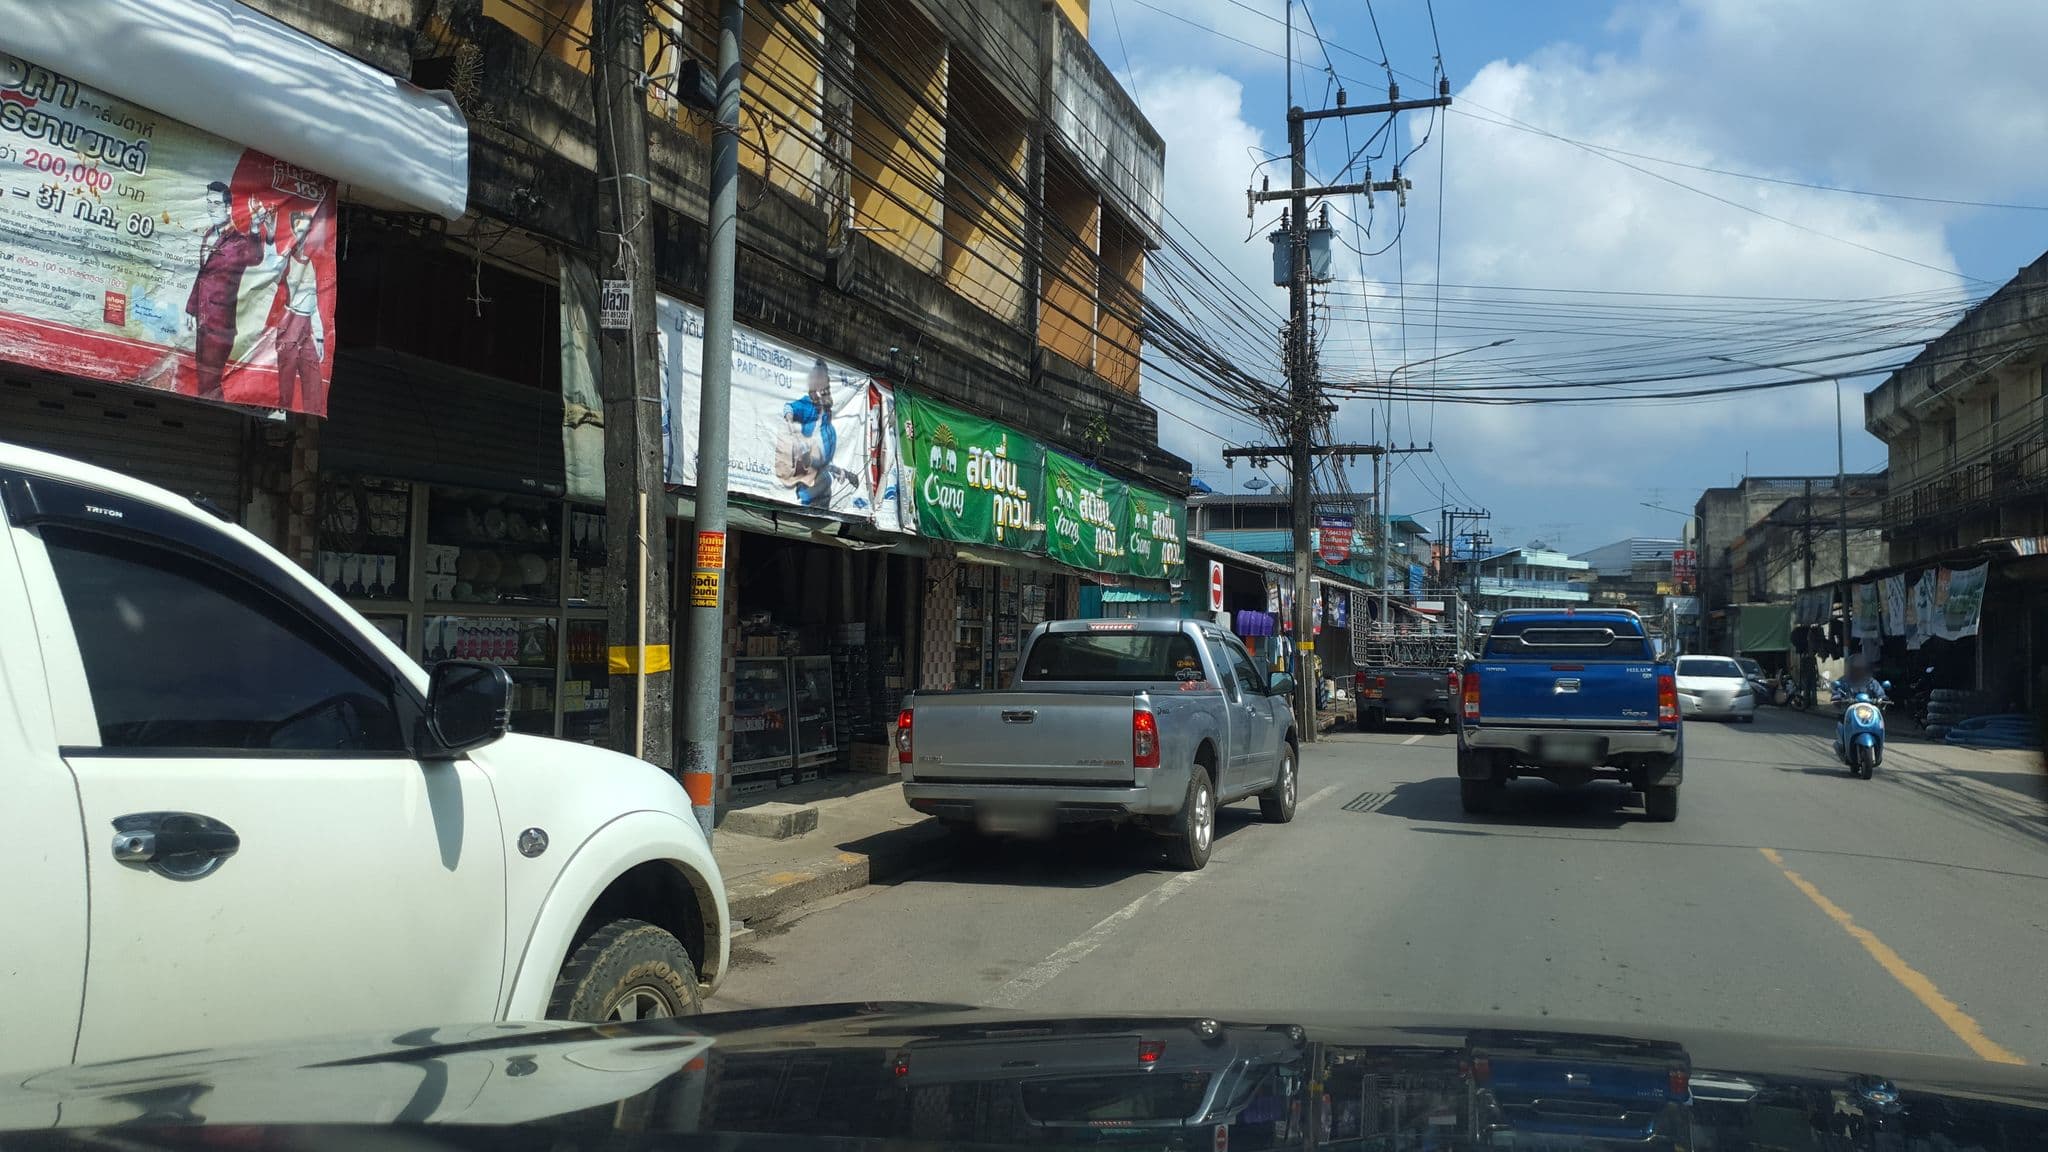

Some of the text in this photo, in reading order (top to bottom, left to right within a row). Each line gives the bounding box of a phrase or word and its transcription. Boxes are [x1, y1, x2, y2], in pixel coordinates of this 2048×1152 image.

[0, 101, 149, 175] รยานยนต์
[23, 148, 113, 191] 200,000
[117, 182, 146, 202] บาท
[36, 184, 67, 213] 31
[73, 198, 119, 230] ก.ค.
[126, 213, 154, 239] 60
[602, 288, 630, 311] ปลวก
[774, 371, 793, 390] YOU
[85, 505, 124, 518] TRITON
